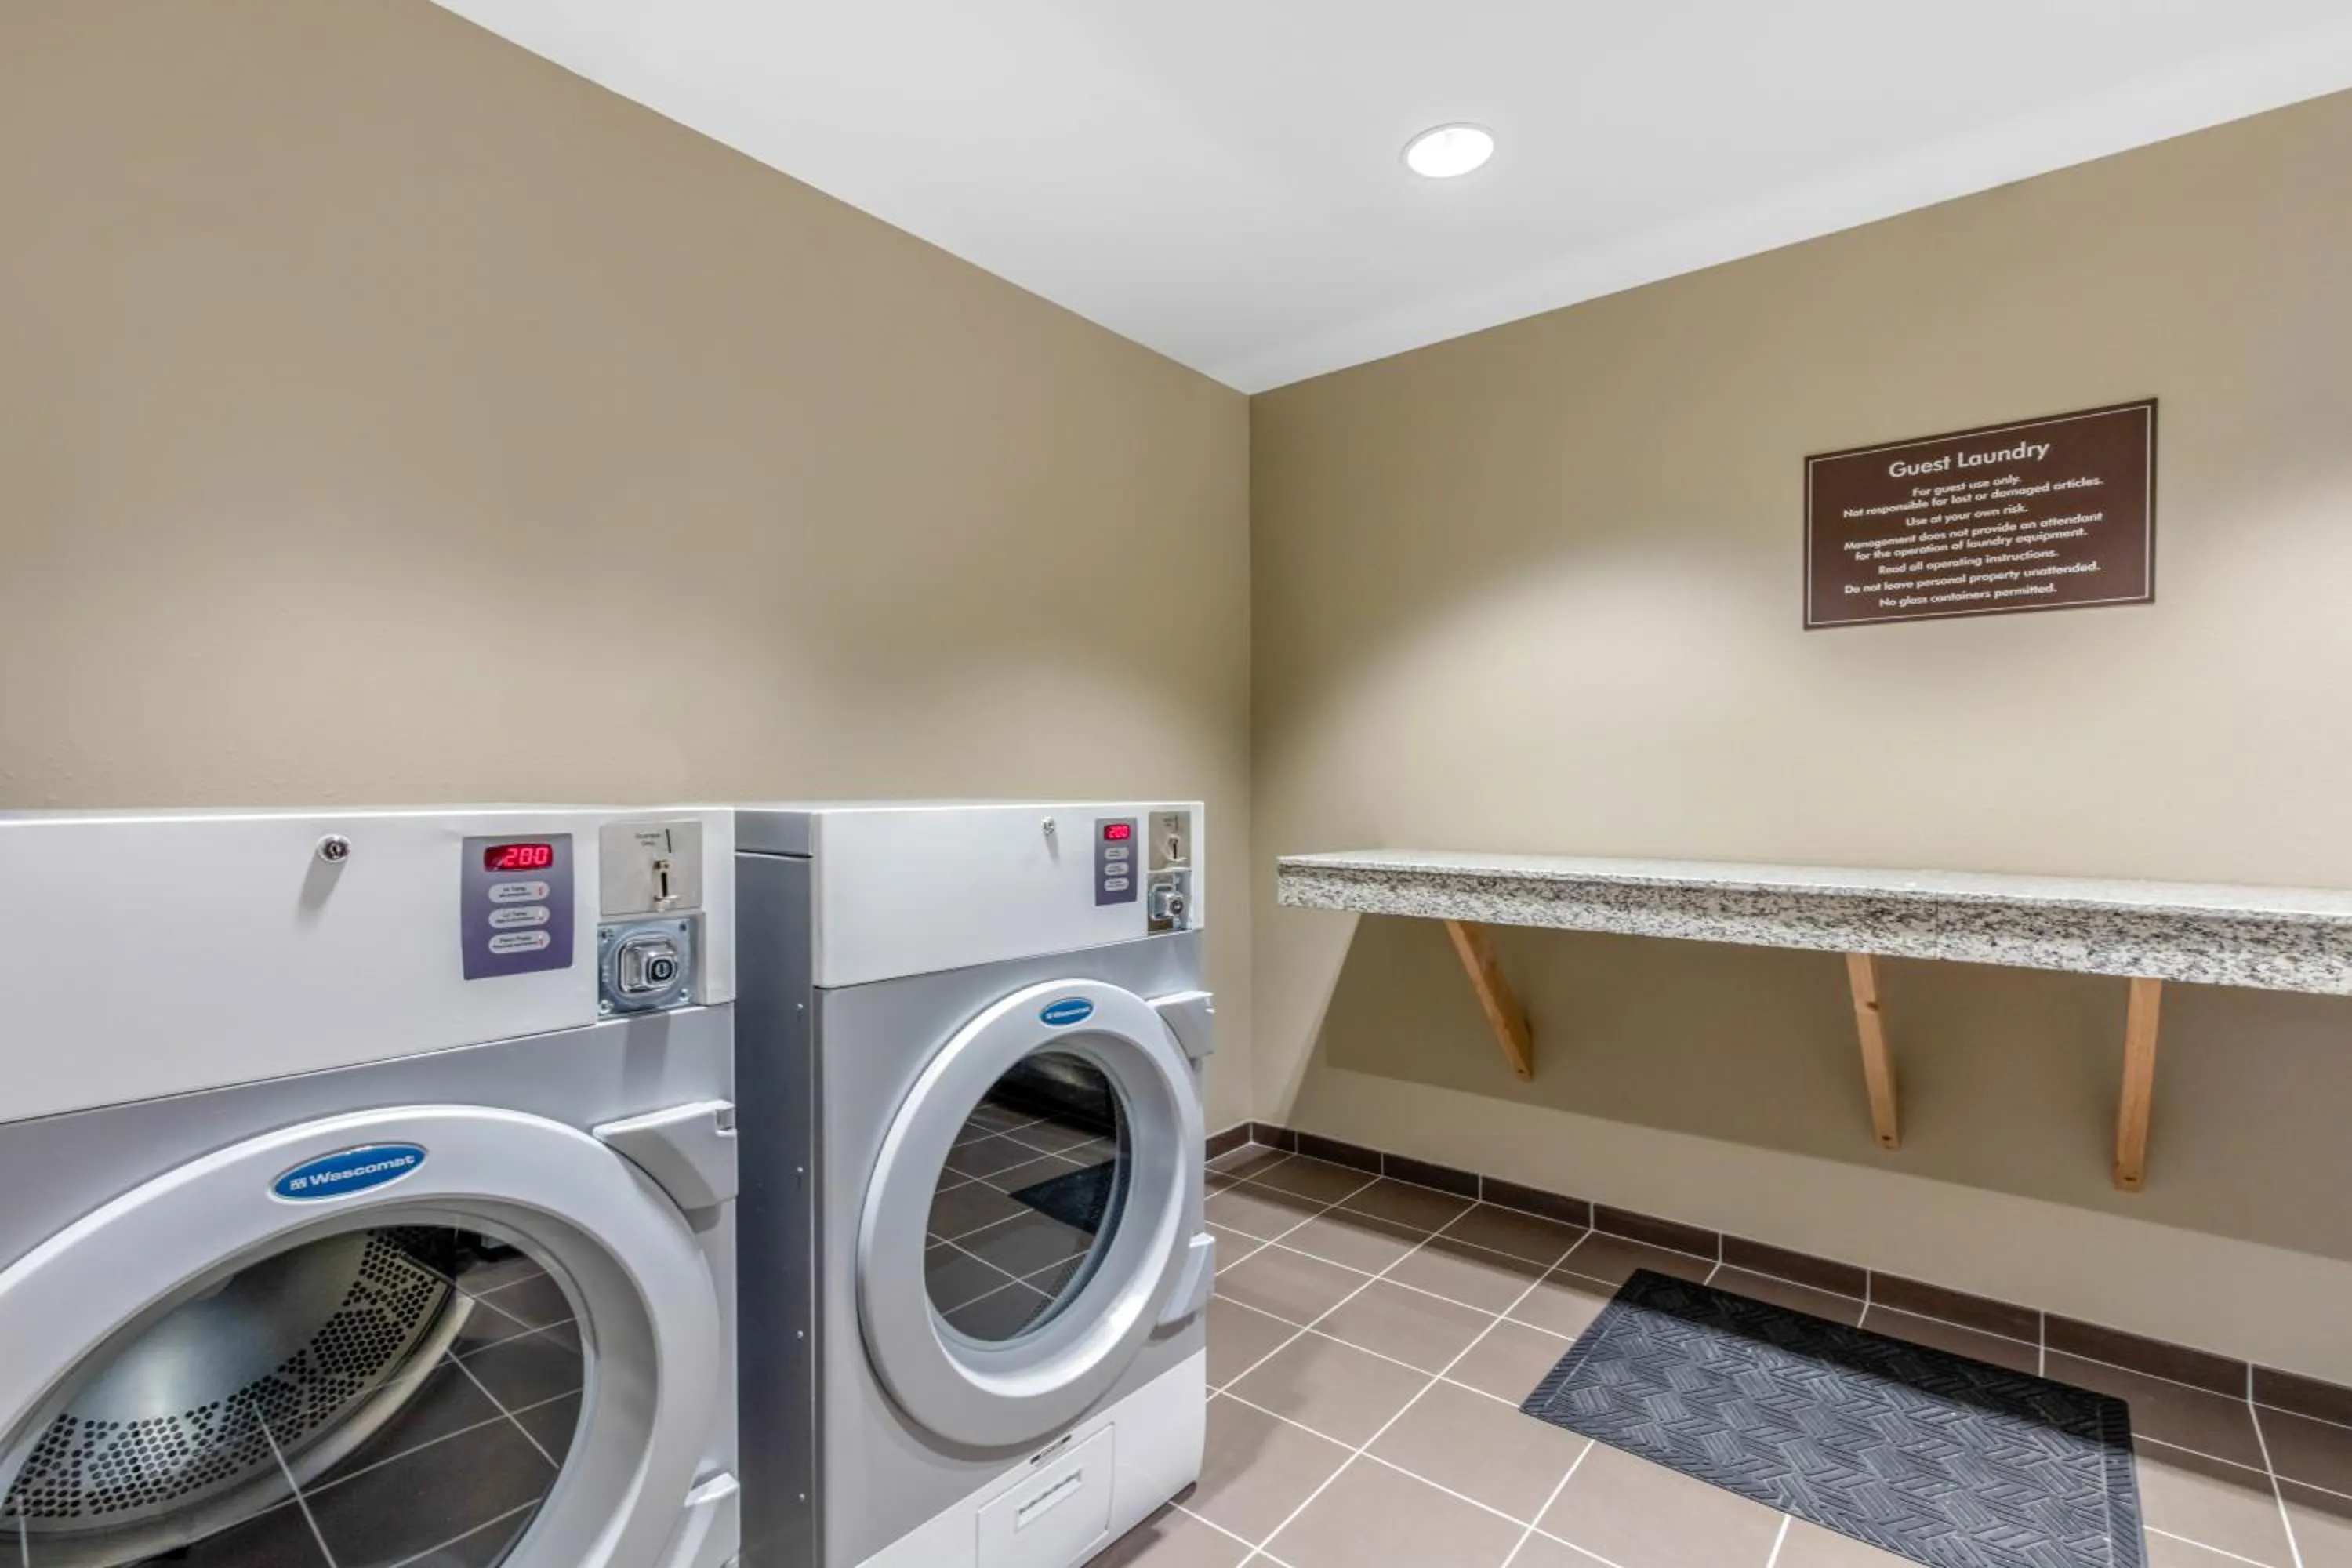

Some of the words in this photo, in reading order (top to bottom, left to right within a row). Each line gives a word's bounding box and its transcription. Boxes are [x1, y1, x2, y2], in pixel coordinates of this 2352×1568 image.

[1888, 455, 1951, 478] Guest
[1957, 441, 2051, 469] Laundry
[1843, 508, 1864, 518] Not
[1865, 499, 1929, 515] responsible
[1931, 496, 1949, 507] for
[1951, 493, 1972, 504] lost
[1974, 493, 1989, 502] or
[1990, 481, 2050, 499] damaged
[2053, 476, 2104, 491] articles.
[1911, 487, 1932, 498] For
[1933, 482, 1965, 496] guest
[1969, 481, 1990, 489] use
[1992, 474, 2021, 486] only.
[1905, 517, 1928, 527] Use
[1929, 514, 1943, 524] at
[1944, 512, 1973, 524] your
[1973, 509, 2001, 518] own
[2002, 503, 2029, 515] risk.
[1843, 535, 1917, 551] Management
[1918, 531, 1947, 542] does
[1948, 528, 1969, 539] not
[1970, 522, 2018, 538] provide
[2019, 521, 2037, 530] an
[2039, 512, 2103, 528] attendant
[1854, 551, 1872, 561] for
[1873, 549, 1893, 559] the
[1893, 543, 1949, 558] operation
[1950, 539, 1964, 550] of
[1965, 535, 2013, 549] laundry
[2015, 528, 2089, 545] equipment.
[1843, 584, 1861, 594] Do
[1862, 582, 1882, 592] not
[1883, 581, 1915, 590] leave
[1915, 573, 1968, 590] personal
[1969, 570, 2020, 584] property
[2023, 561, 2102, 578] unattended.
[1878, 562, 1907, 575] Read
[1908, 560, 1924, 572] all
[1926, 557, 1983, 572] operating
[1984, 549, 2060, 564] instructions.
[1878, 597, 1897, 608] No
[1898, 595, 1929, 608] glass
[1929, 590, 1992, 604] containers
[1993, 583, 2058, 600] permitted.
[310, 1155, 416, 1185] Wascomat
